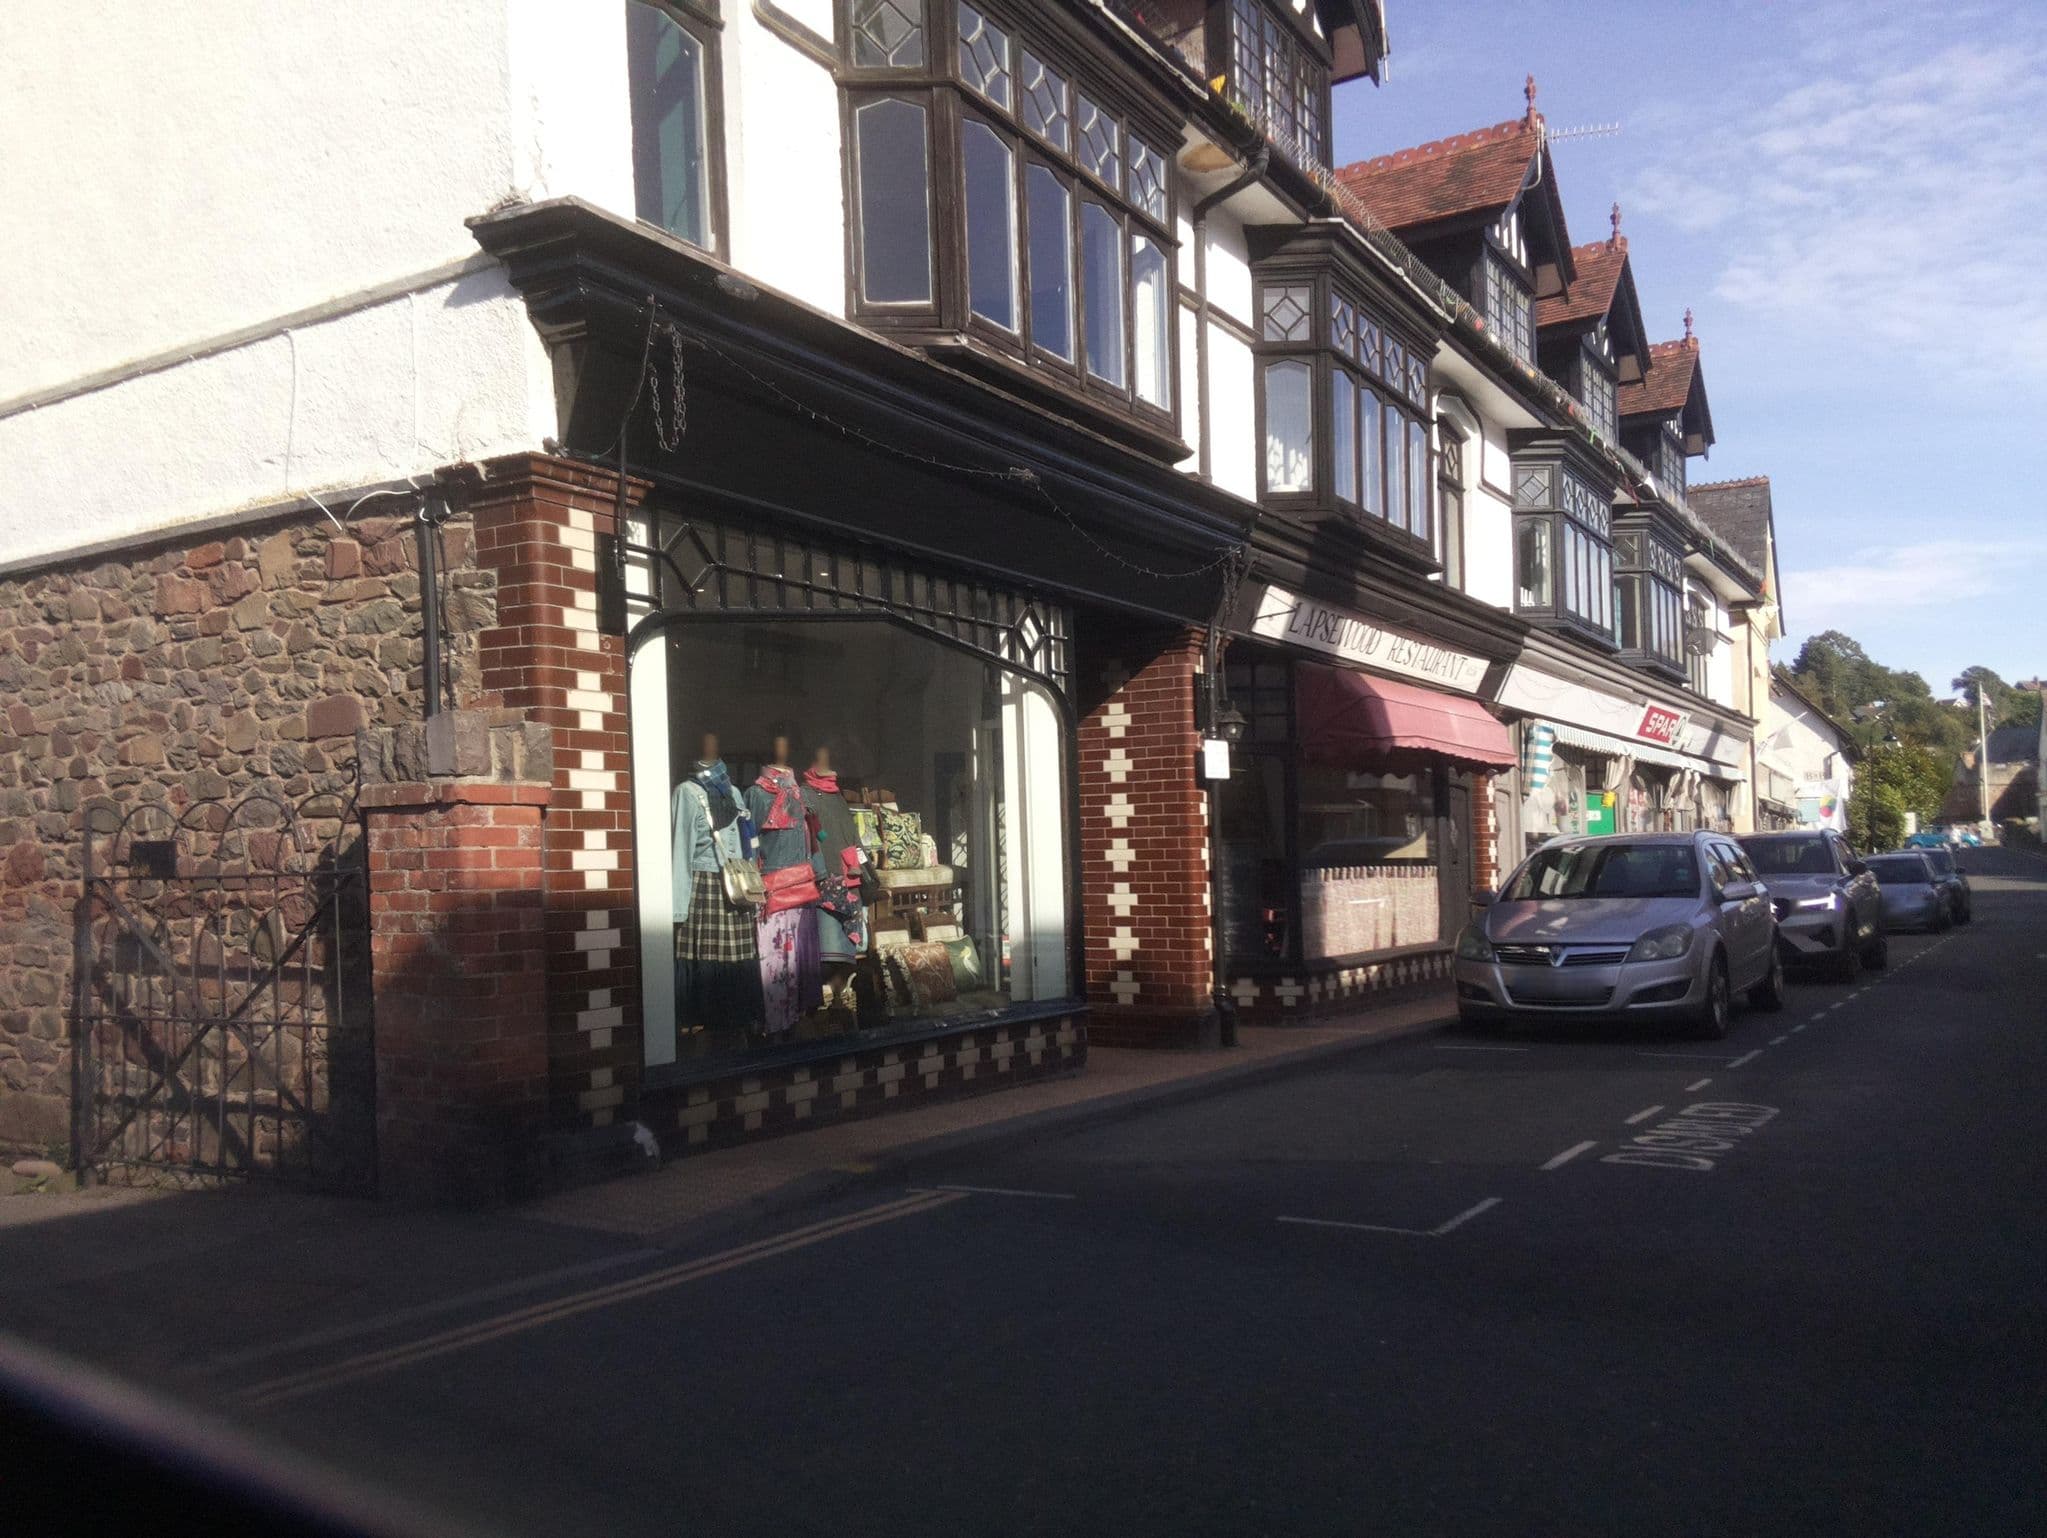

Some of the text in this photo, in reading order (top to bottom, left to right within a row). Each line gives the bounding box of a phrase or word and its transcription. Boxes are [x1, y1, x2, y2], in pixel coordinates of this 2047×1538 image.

[1387, 637, 1468, 680] RESTAURANT
[1645, 712, 1678, 739] SPAR
[1600, 1102, 1780, 1171] DISABLED
